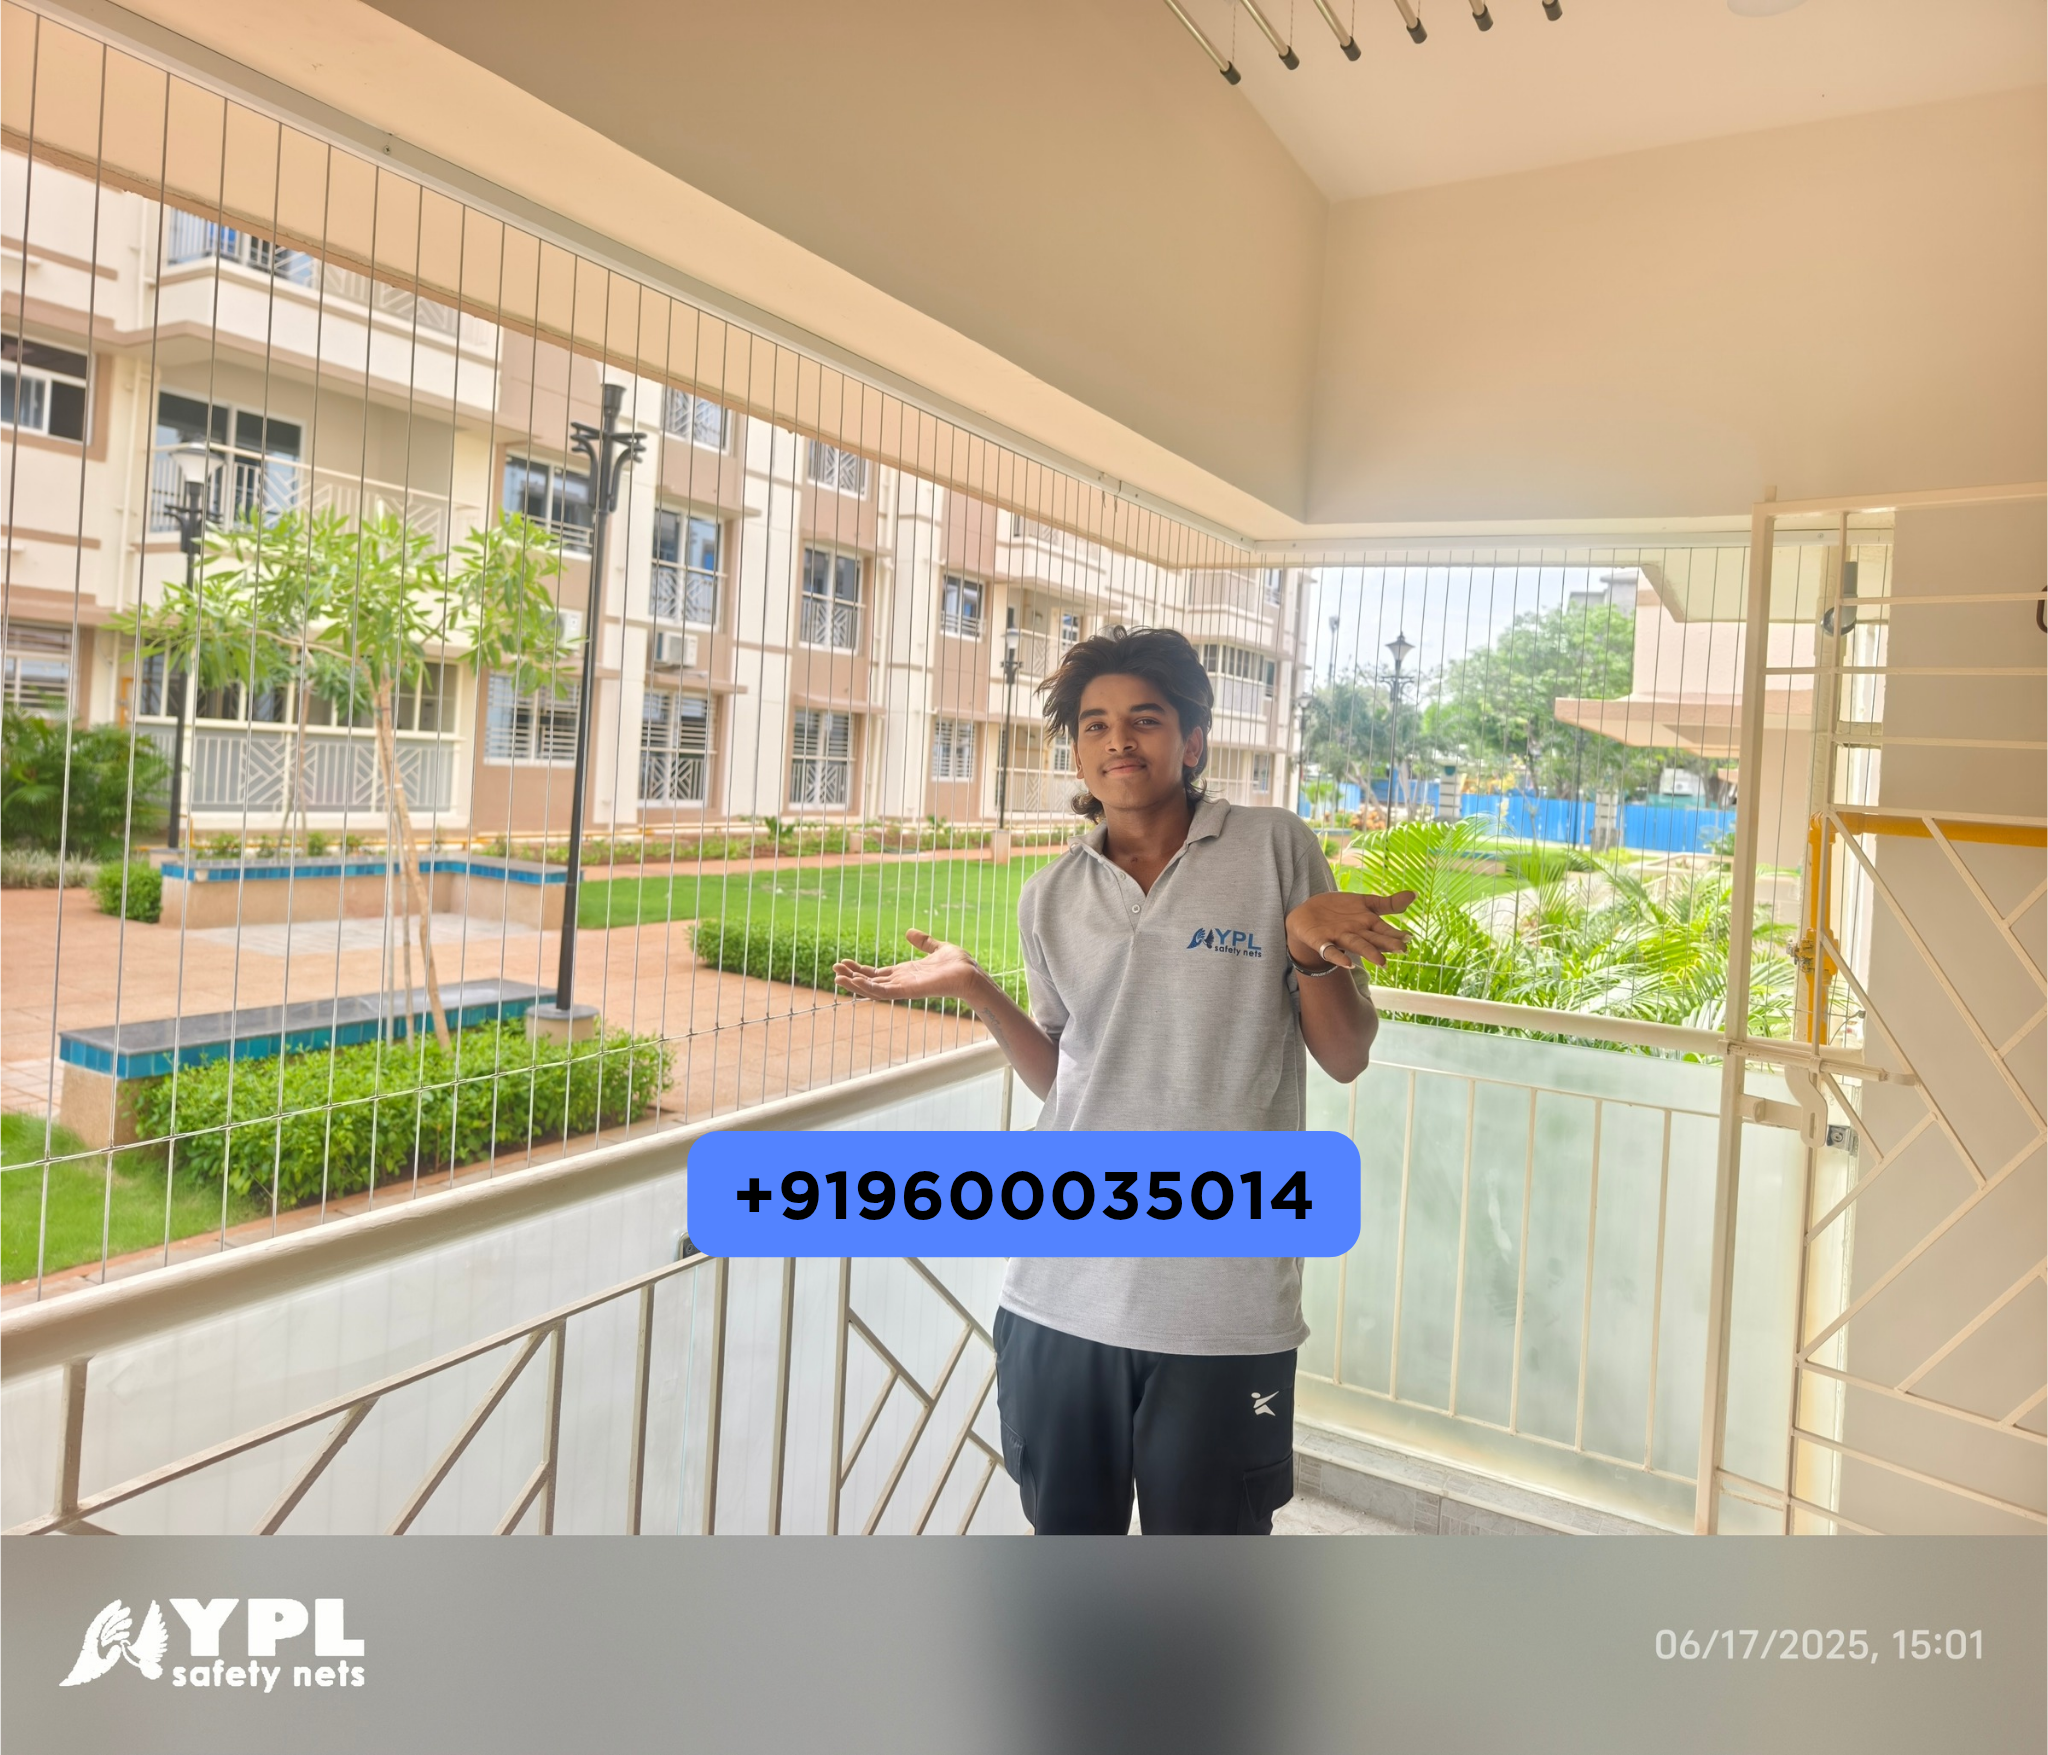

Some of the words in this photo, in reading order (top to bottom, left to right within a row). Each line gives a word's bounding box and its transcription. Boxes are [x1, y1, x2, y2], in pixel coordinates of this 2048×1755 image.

[1214, 928, 1262, 950] YPL
[1214, 944, 1241, 956] safety
[1243, 949, 1262, 958] nets
